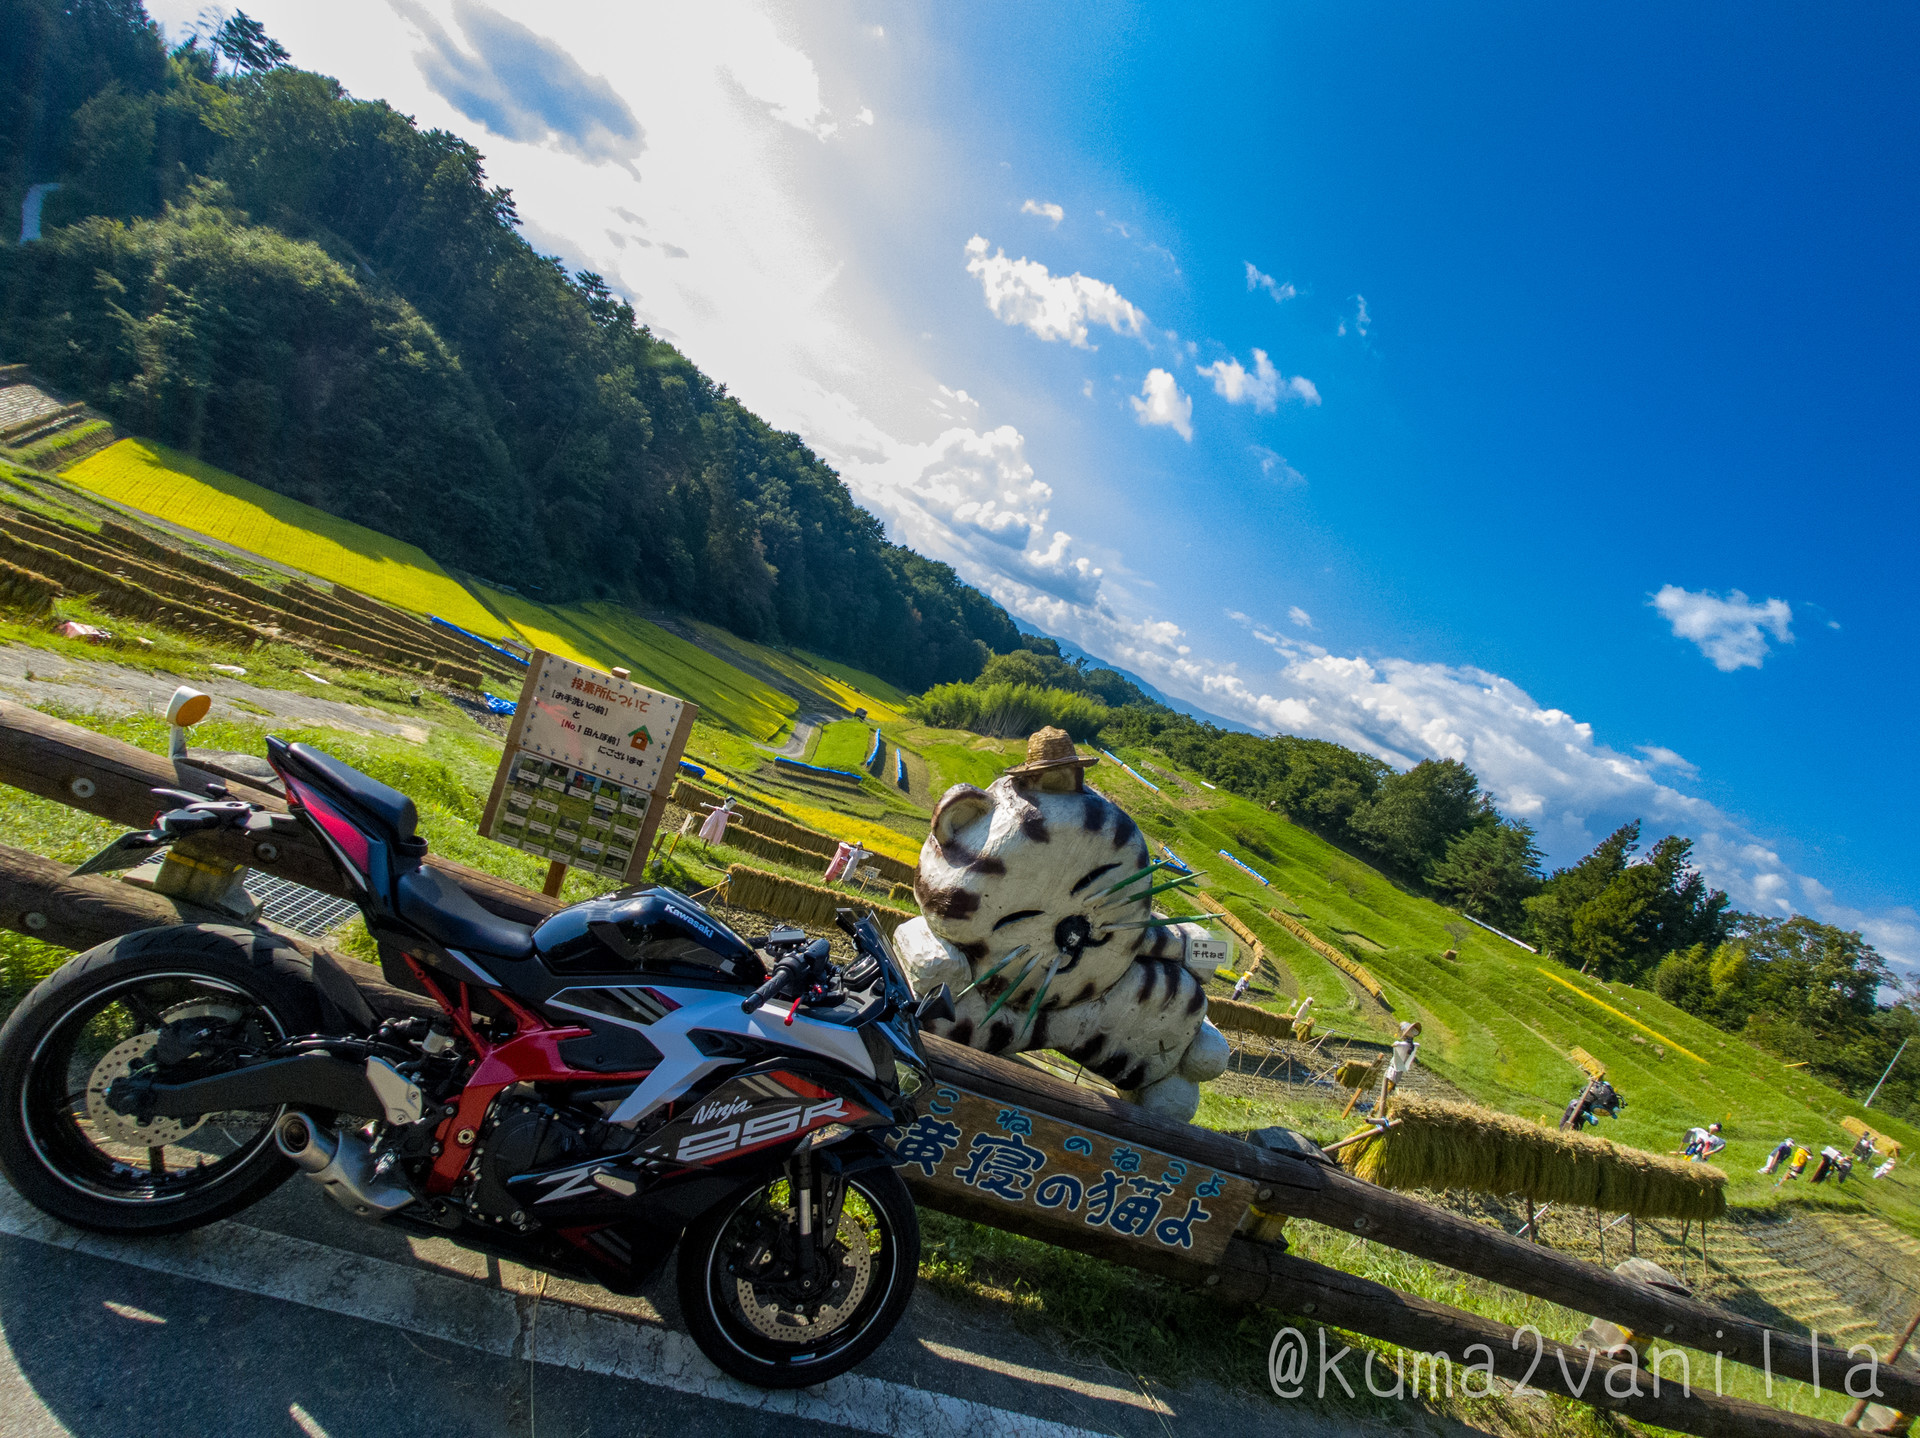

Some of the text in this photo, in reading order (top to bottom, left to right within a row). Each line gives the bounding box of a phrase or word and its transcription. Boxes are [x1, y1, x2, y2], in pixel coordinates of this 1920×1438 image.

[571, 677, 650, 713] 投票所について
[572, 711, 581, 719] と
[598, 745, 644, 767] にございます
[664, 904, 714, 938] Kawasaki
[1193, 950, 1225, 959] 千代ねぎ
[692, 1096, 752, 1125] Ninja
[675, 1098, 849, 1162] 25R
